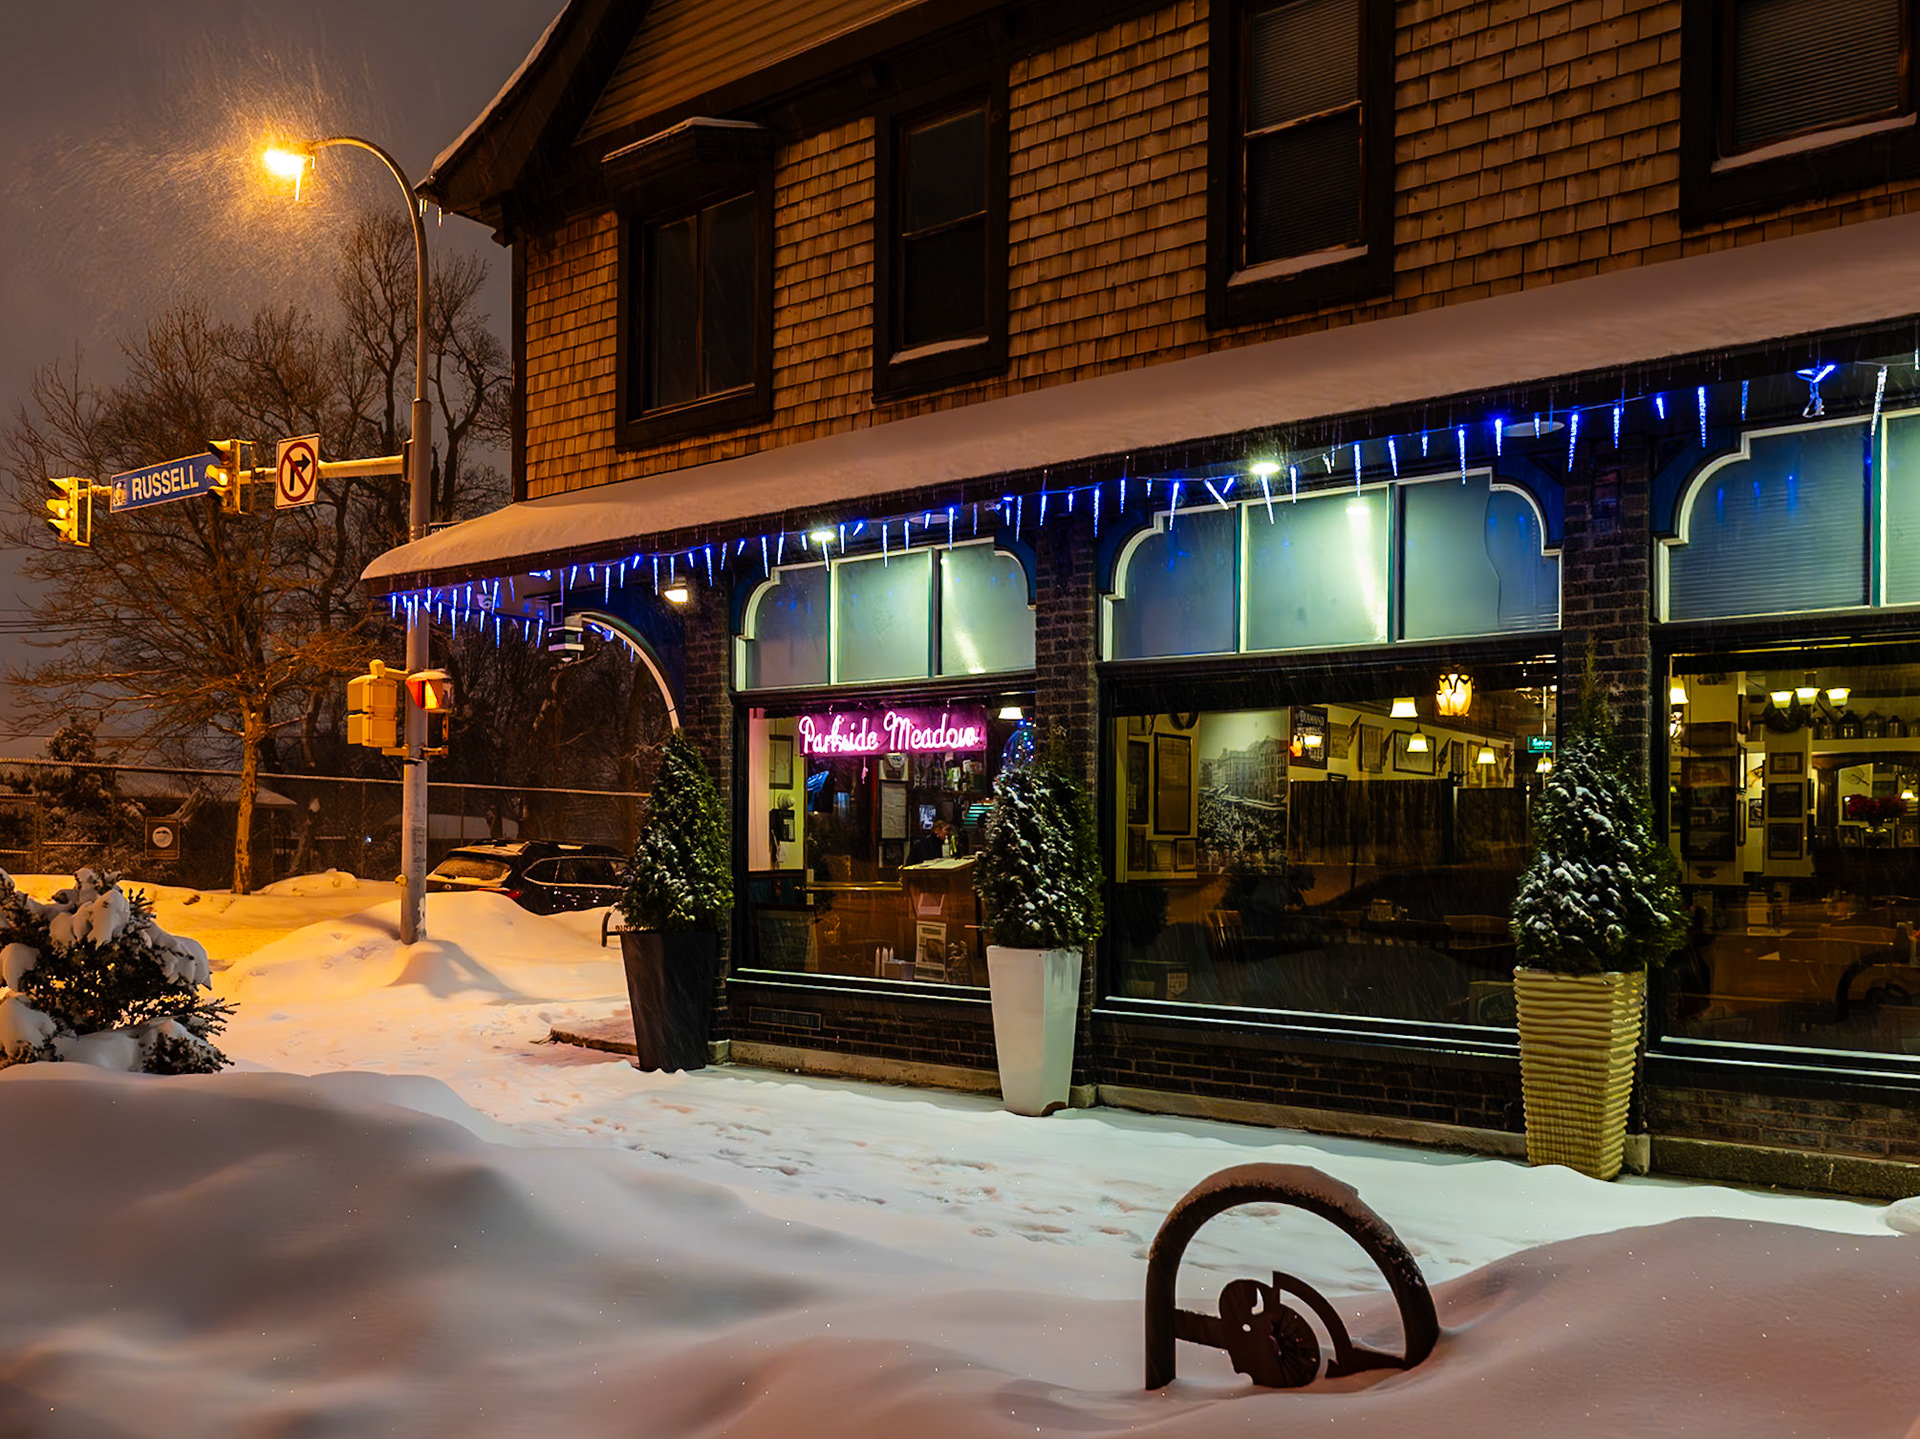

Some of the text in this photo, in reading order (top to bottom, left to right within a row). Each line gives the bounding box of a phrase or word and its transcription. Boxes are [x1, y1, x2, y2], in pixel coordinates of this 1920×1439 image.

[132, 464, 199, 501] RUSSELL
[799, 711, 979, 754] Parkside Meadow
